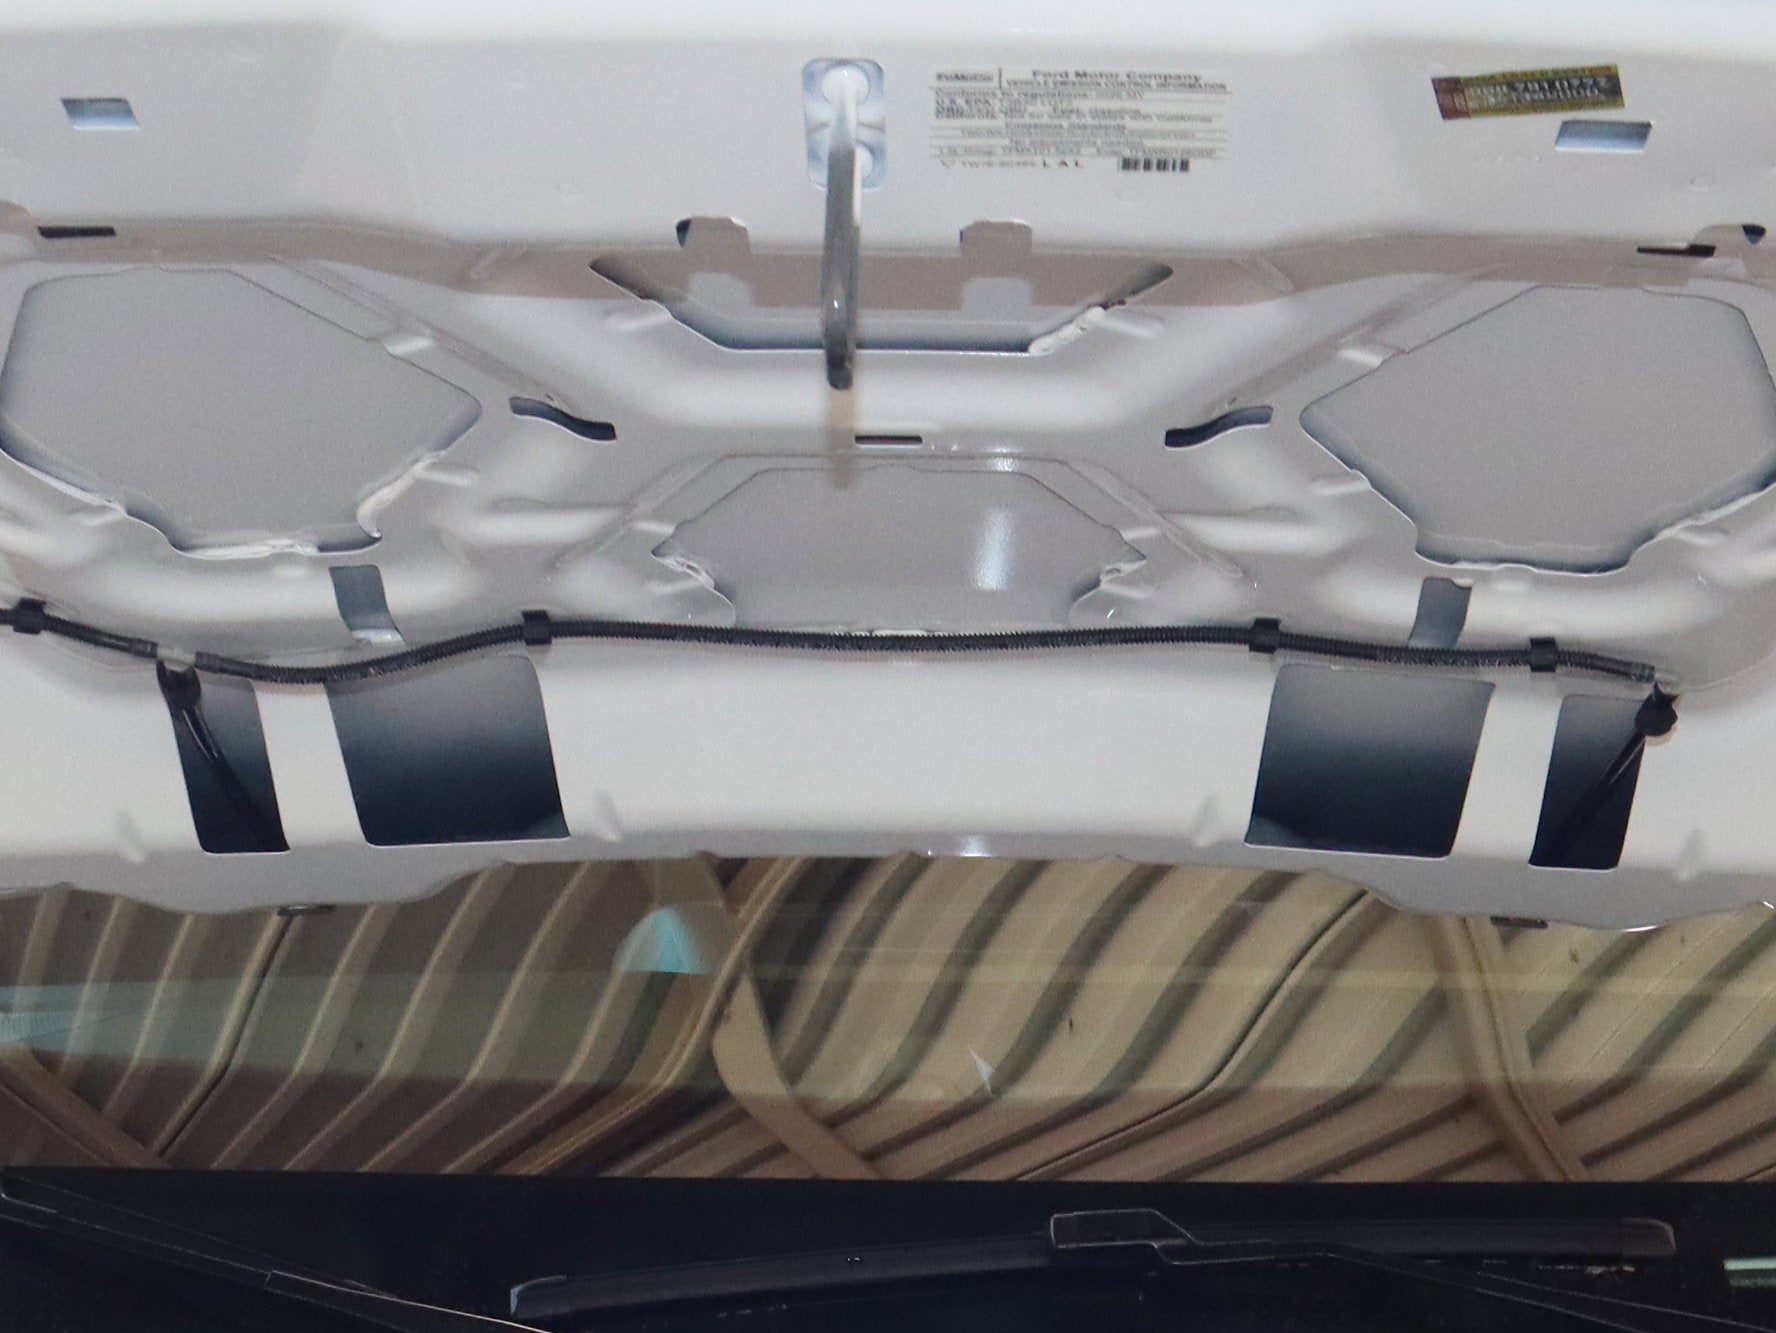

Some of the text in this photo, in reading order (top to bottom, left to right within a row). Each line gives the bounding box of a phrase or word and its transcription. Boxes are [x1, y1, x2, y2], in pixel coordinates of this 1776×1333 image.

[1031, 69, 1202, 83] Ford Motor Company
